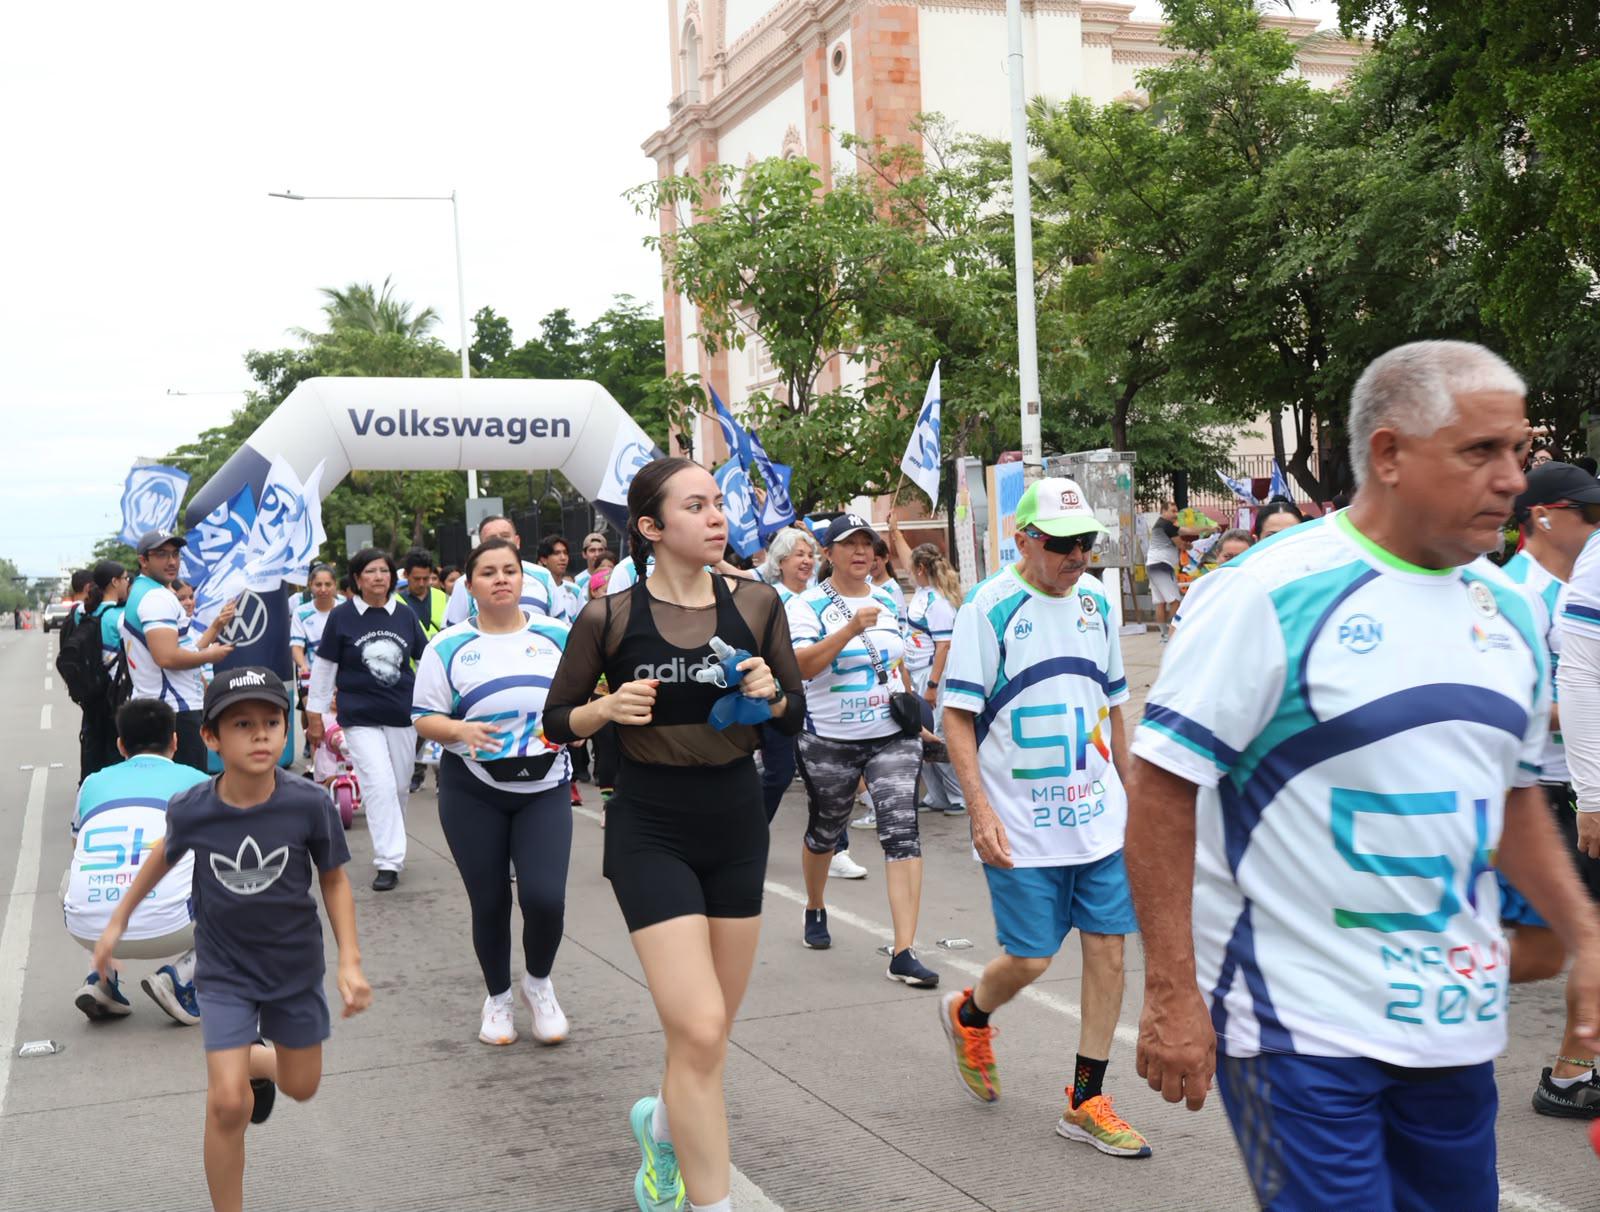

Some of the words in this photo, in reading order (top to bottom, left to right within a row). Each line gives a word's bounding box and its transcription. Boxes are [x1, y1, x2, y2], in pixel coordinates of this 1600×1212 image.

[347, 408, 571, 445] Volkswagen
[1338, 621, 1384, 645] PAN
[460, 652, 481, 664] PAN
[633, 657, 711, 683] adid
[840, 695, 891, 709] MAQU
[839, 705, 892, 724] 202
[88, 873, 133, 885] MAQ
[88, 886, 157, 903] 20
[1379, 942, 1508, 979] MAQU
[1386, 982, 1508, 1025] 202
